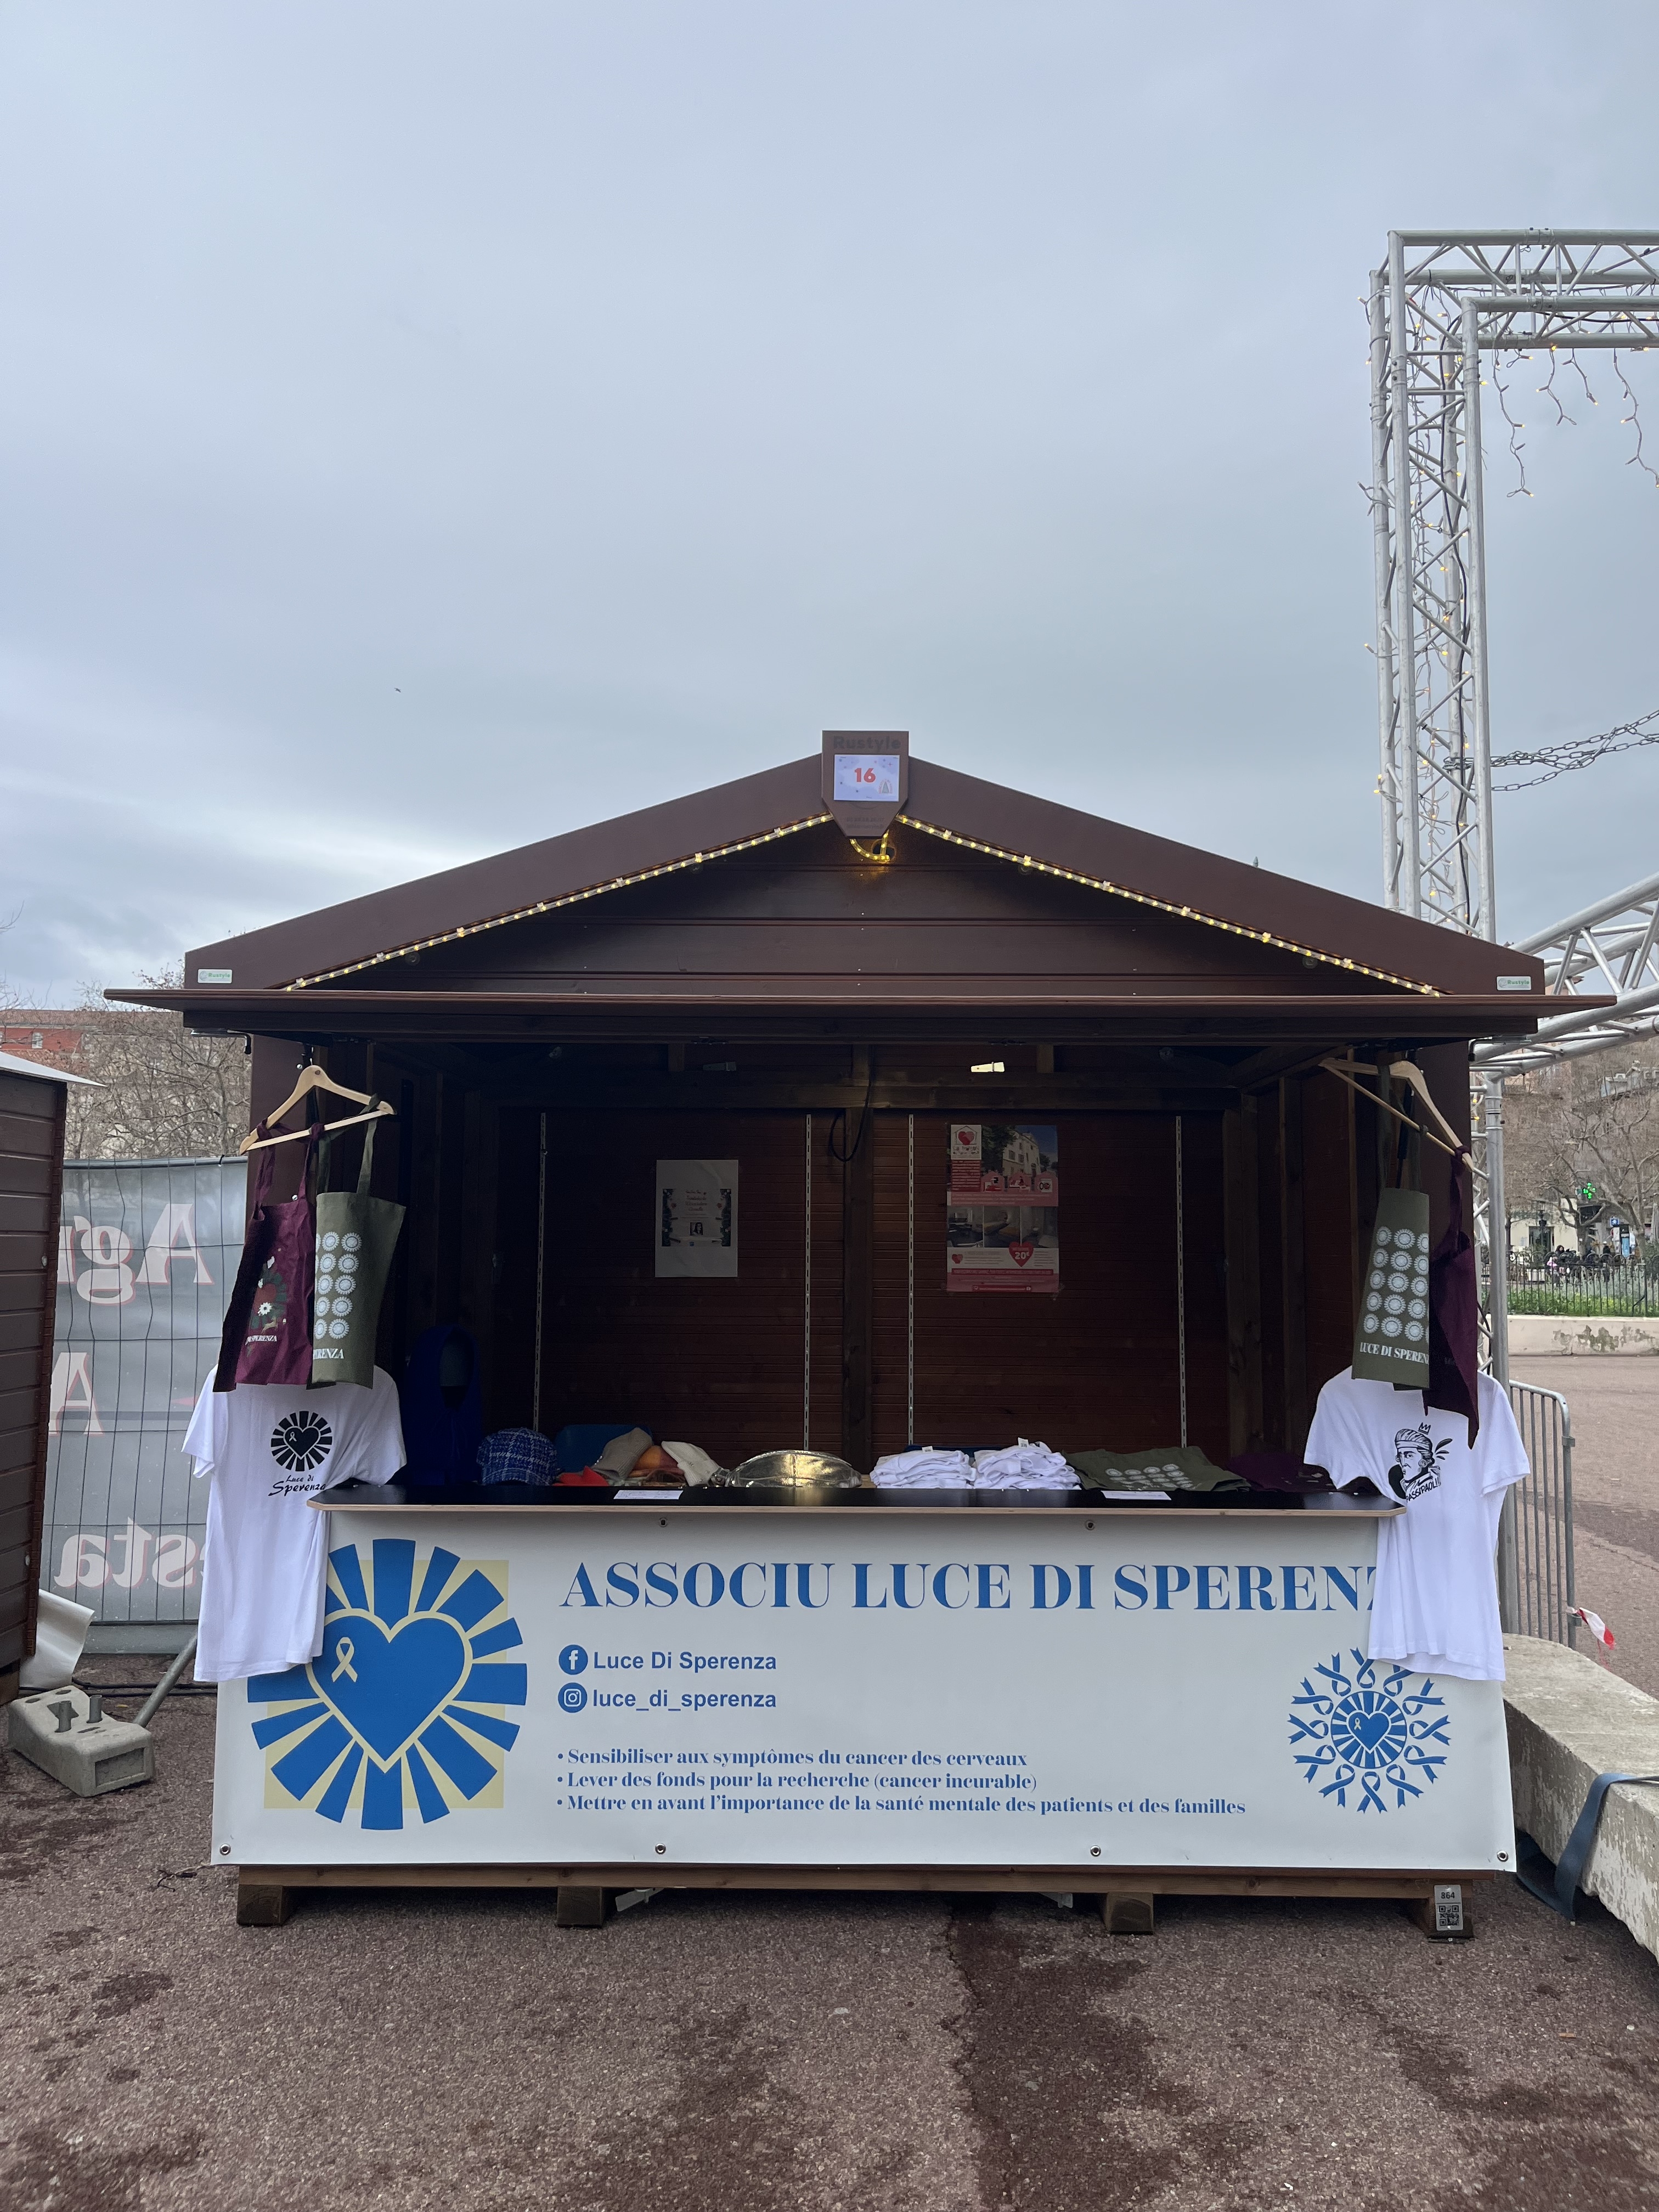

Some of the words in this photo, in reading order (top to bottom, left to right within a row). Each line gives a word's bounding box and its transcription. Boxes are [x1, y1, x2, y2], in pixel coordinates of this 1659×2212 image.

[833, 735, 901, 752] Rustyle
[854, 768, 876, 783] 16
[1359, 1342, 1379, 1355] LUCE
[1380, 1345, 1392, 1357] DI
[268, 1480, 326, 1497] Sperenza
[558, 1561, 836, 1609] ASSOCIU
[851, 1562, 1011, 1610] LUCE
[1029, 1564, 1096, 1610] DI
[593, 1652, 644, 1670] Luce
[651, 1651, 672, 1669] Di
[679, 1651, 777, 1674] Sperenza
[592, 1689, 777, 1712] luce_di_sperenza
[567, 1748, 674, 1765] Sensibiliser
[676, 1753, 709, 1765] aux
[713, 1749, 814, 1769] symptômes
[817, 1750, 841, 1765] du
[845, 1753, 909, 1765] cancer
[911, 1750, 943, 1765] des
[945, 1754, 1028, 1767] cerveaux
[567, 1772, 618, 1788] Lever
[621, 1771, 652, 1787] des
[656, 1771, 706, 1787] fonds
[709, 1775, 753, 1791] pour
[757, 1772, 773, 1788] la
[777, 1772, 870, 1788] recherche
[873, 1773, 941, 1791] (cancer
[945, 1773, 1037, 1792] incurable)
[567, 1795, 627, 1810] Mettre
[630, 1799, 653, 1810] en
[657, 1797, 706, 1811] avant
[828, 1795, 850, 1811] de
[854, 1795, 871, 1811] la
[876, 1795, 924, 1812] santé
[928, 1796, 1001, 1812] mentale
[1005, 1796, 1037, 1812] des
[1040, 1796, 1114, 1815] patients
[1116, 1800, 1135, 1813] et
[1138, 1798, 1170, 1813] des
[1174, 1798, 1247, 1814] familles
